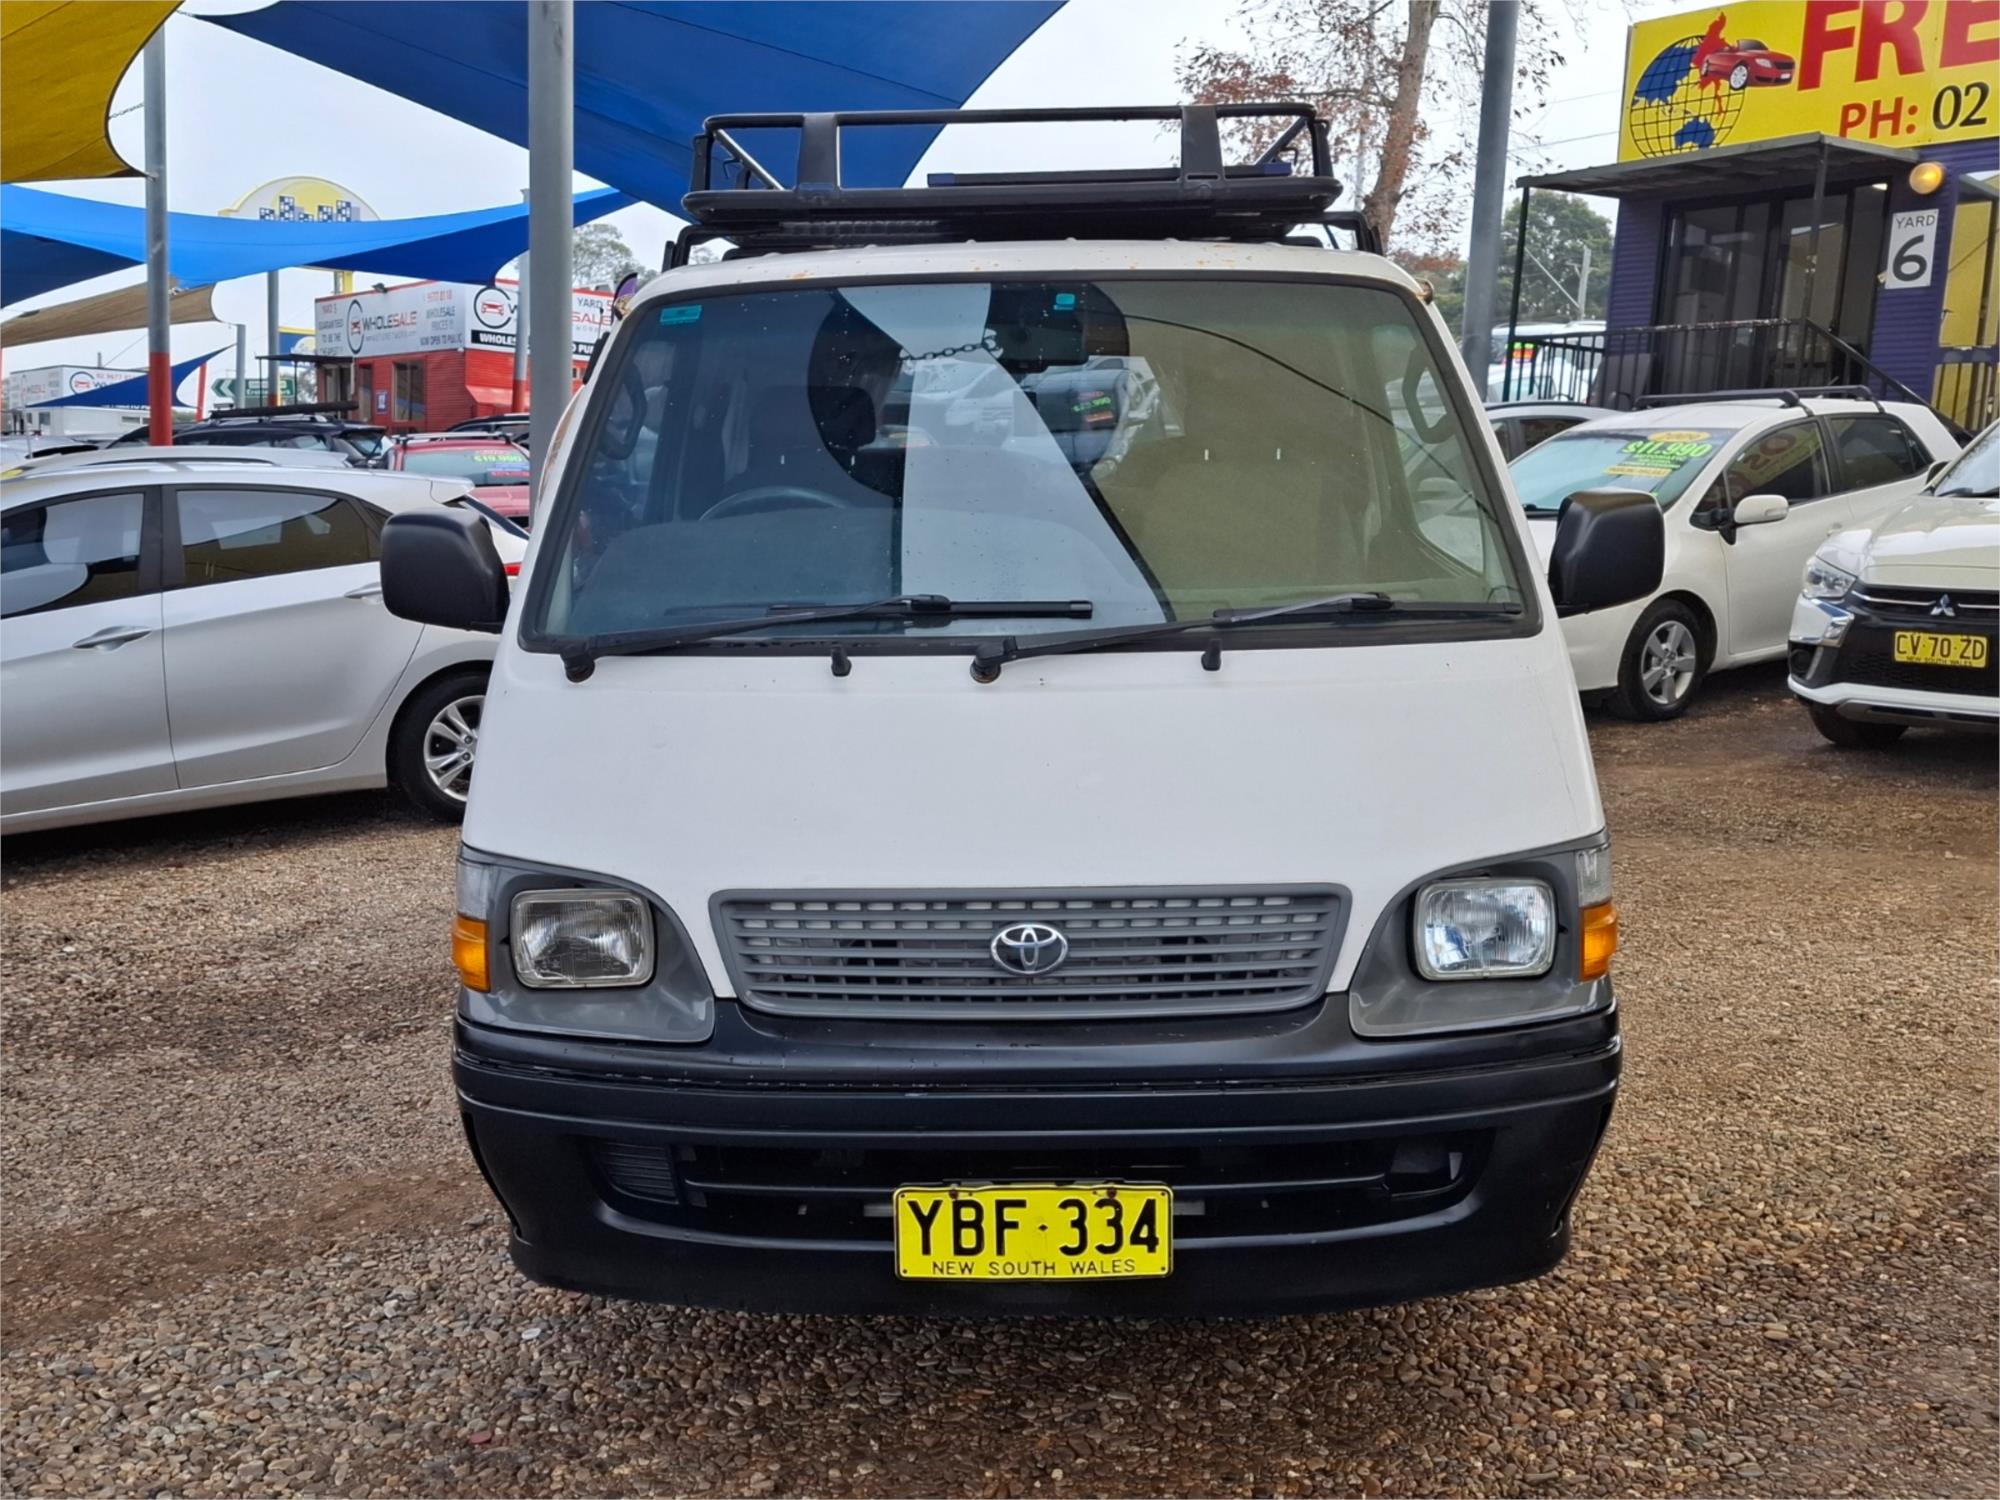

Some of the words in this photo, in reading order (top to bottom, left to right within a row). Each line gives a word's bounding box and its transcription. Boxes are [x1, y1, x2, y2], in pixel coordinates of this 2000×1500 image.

[1839, 96, 1919, 139] PH:
[1932, 81, 1990, 130] 02
[1896, 214, 1936, 229] YARD
[1892, 234, 1928, 282] 6
[577, 297, 604, 309] YARD
[362, 311, 418, 331] WHOLESALE
[1896, 634, 1921, 656] CV
[1928, 637, 1951, 658] 70
[1959, 639, 1985, 661] ZD
[907, 1198, 1027, 1257] YBF
[1057, 1198, 1160, 1257] 334
[932, 1261, 975, 1276] NEW
[988, 1260, 1056, 1276] SOUTH
[1070, 1259, 1136, 1275] WALES
